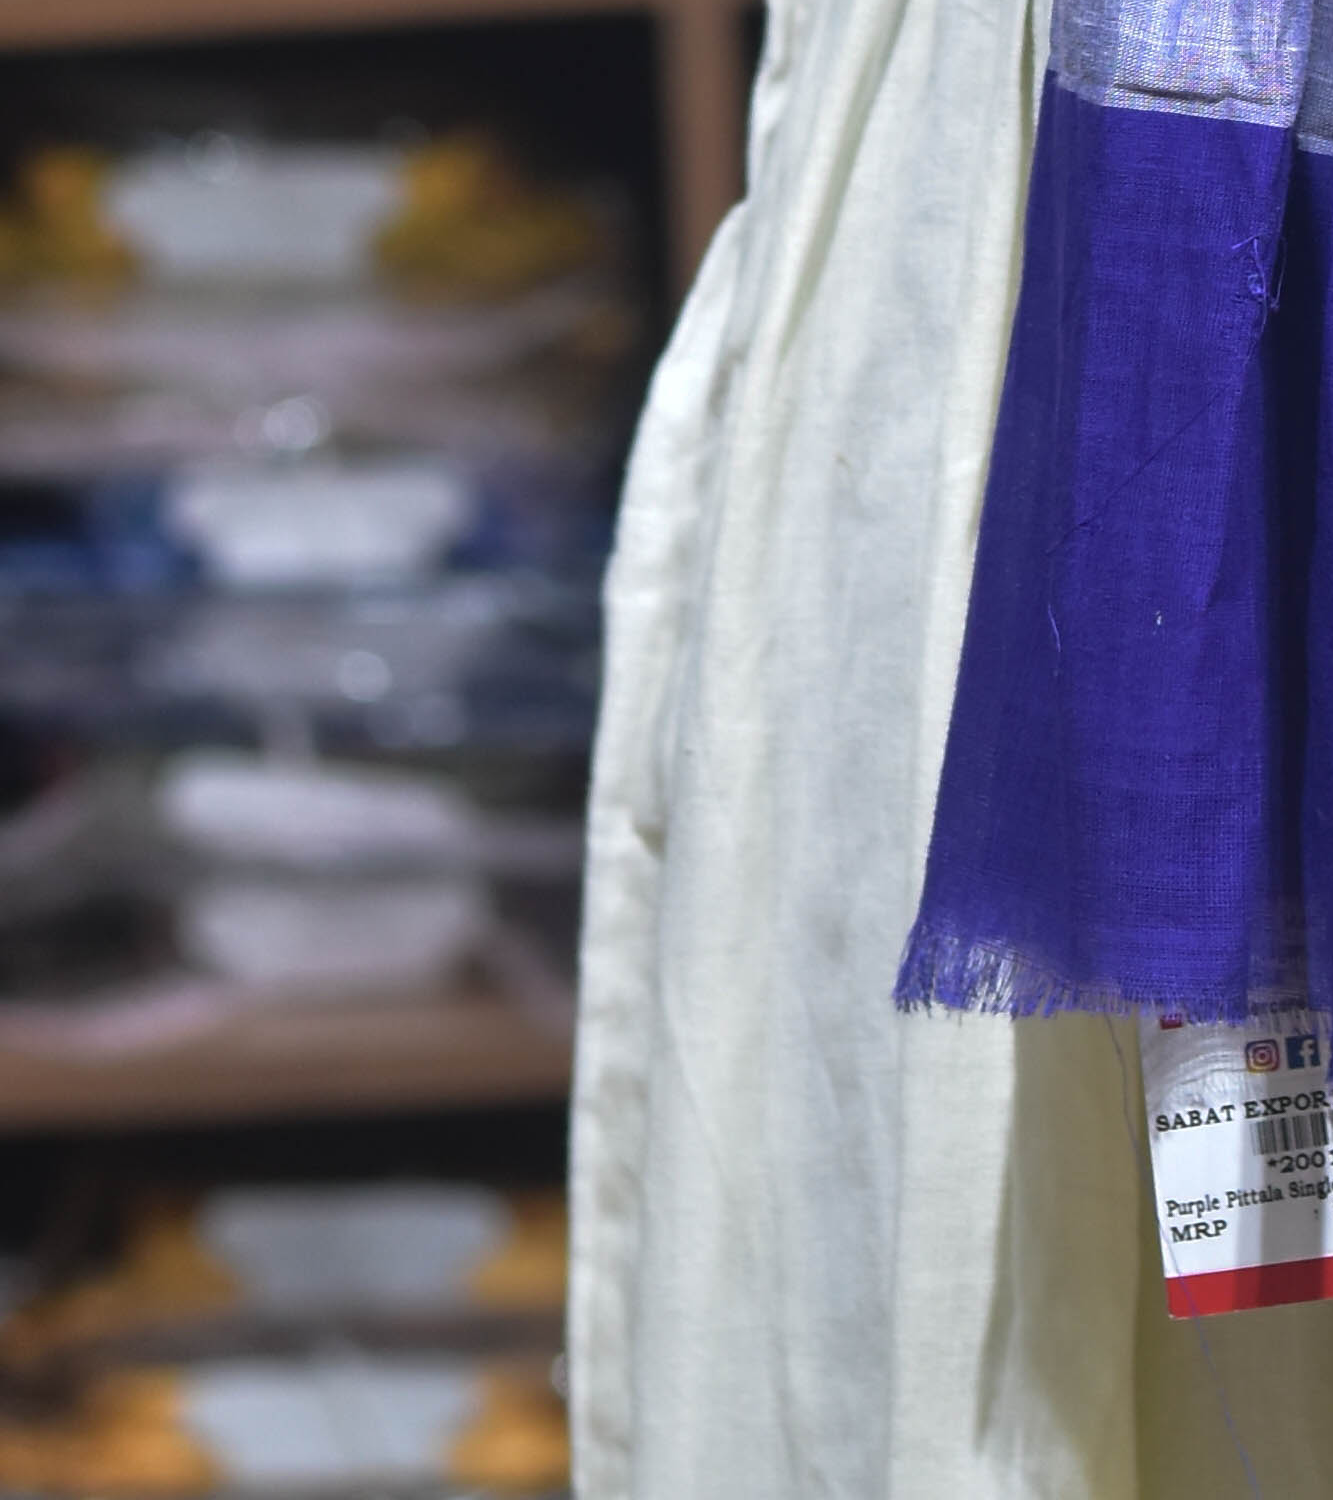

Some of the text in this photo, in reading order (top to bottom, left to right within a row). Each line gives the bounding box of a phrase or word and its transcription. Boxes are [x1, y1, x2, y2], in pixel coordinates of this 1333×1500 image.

[1155, 1104, 1236, 1133] SABAT
[1165, 1194, 1221, 1219] Purple
[1225, 1184, 1285, 1209] Pittala
[1170, 1219, 1228, 1244] MRP
